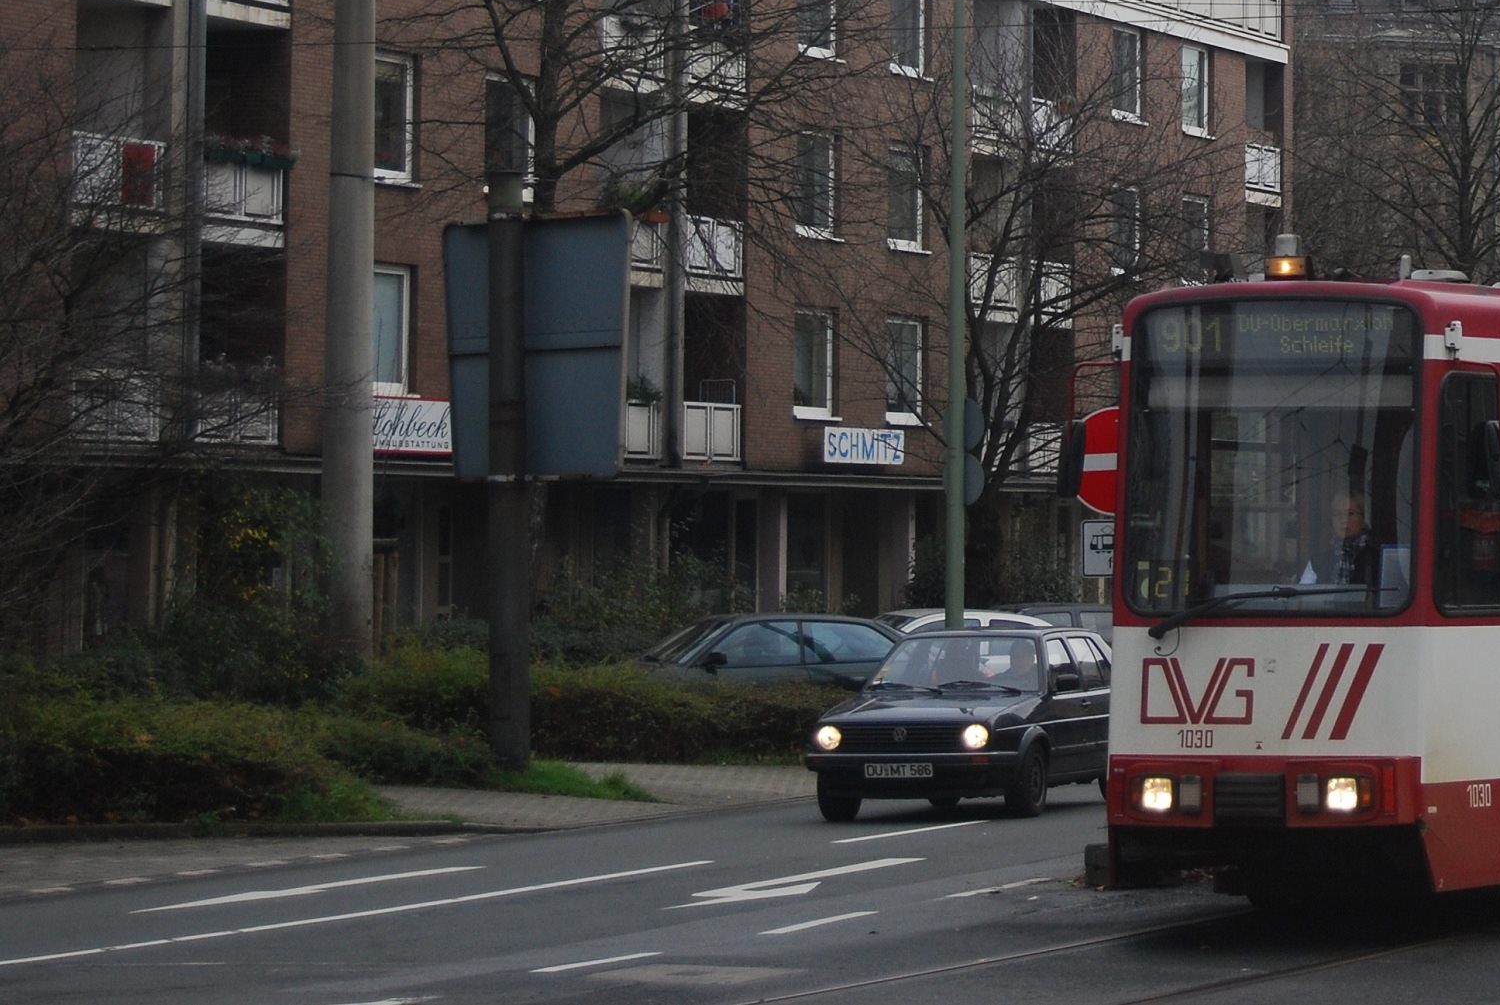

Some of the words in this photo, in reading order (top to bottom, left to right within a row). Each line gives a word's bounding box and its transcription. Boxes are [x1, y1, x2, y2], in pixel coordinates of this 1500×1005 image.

[1162, 316, 1222, 353] 901
[1280, 336, 1354, 353] Schleife
[828, 431, 902, 462] SCHMITZ
[1140, 658, 1255, 725] DVG
[1177, 729, 1214, 749] 1030
[1467, 783, 1492, 808] 1030
